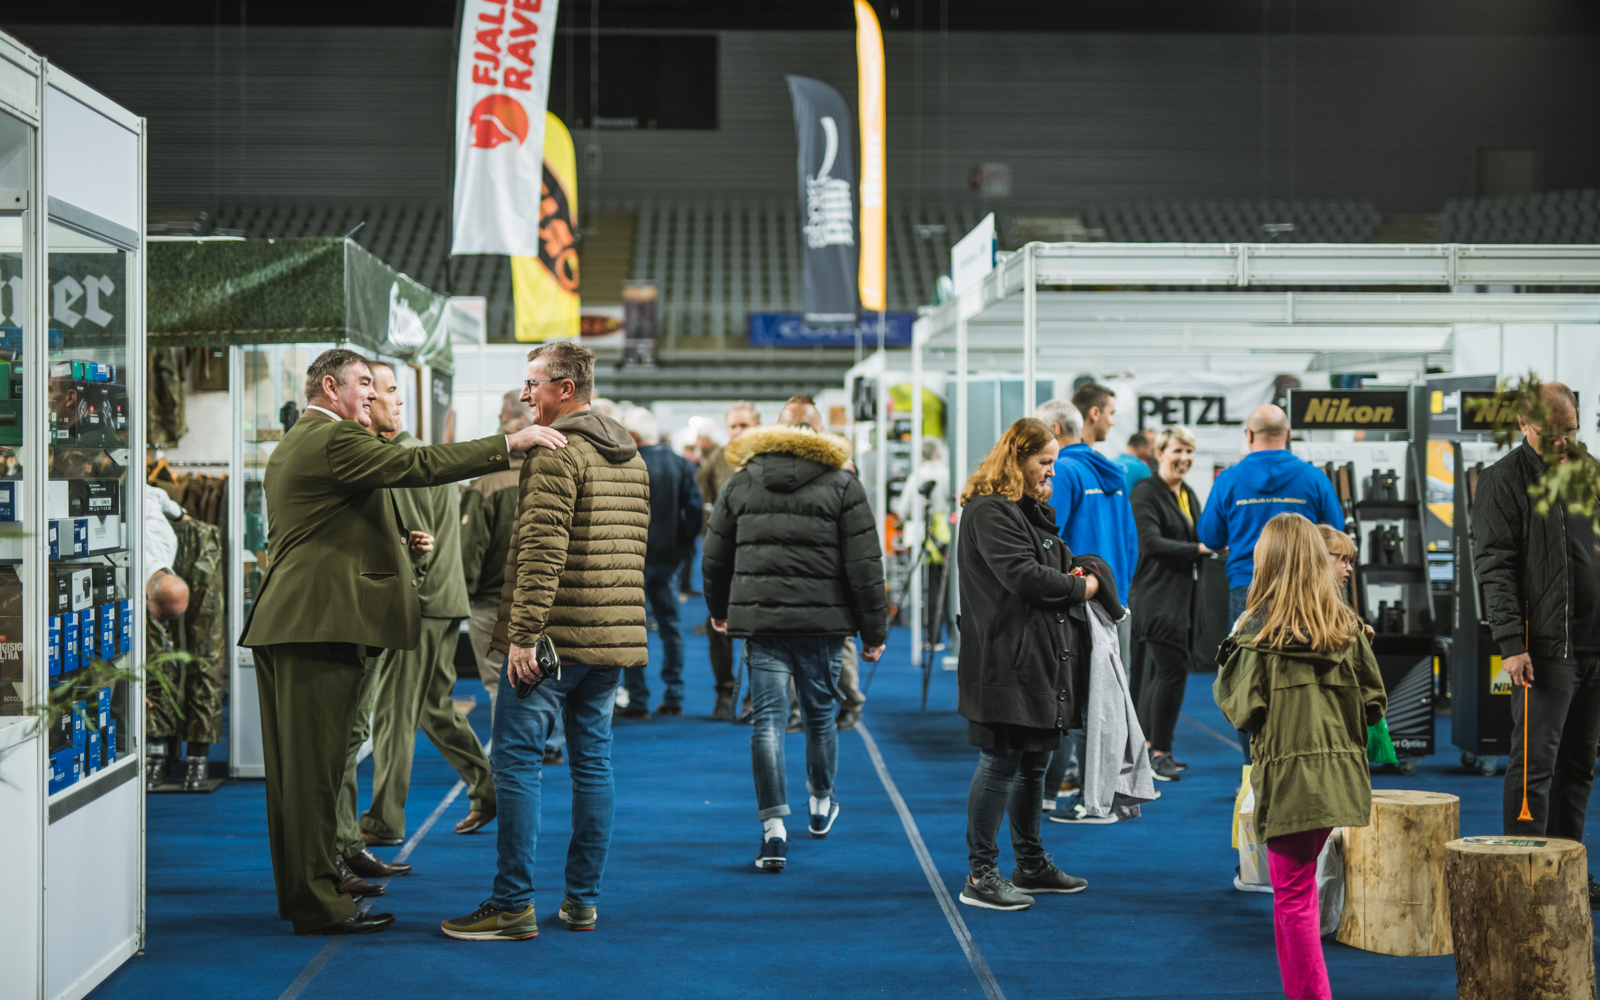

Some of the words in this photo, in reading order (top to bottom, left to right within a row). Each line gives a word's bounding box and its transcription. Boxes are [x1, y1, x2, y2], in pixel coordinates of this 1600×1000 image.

[1138, 396, 1243, 430] PETZL
[1304, 397, 1394, 423] Nikon
[1401, 738, 1427, 750] Optics
